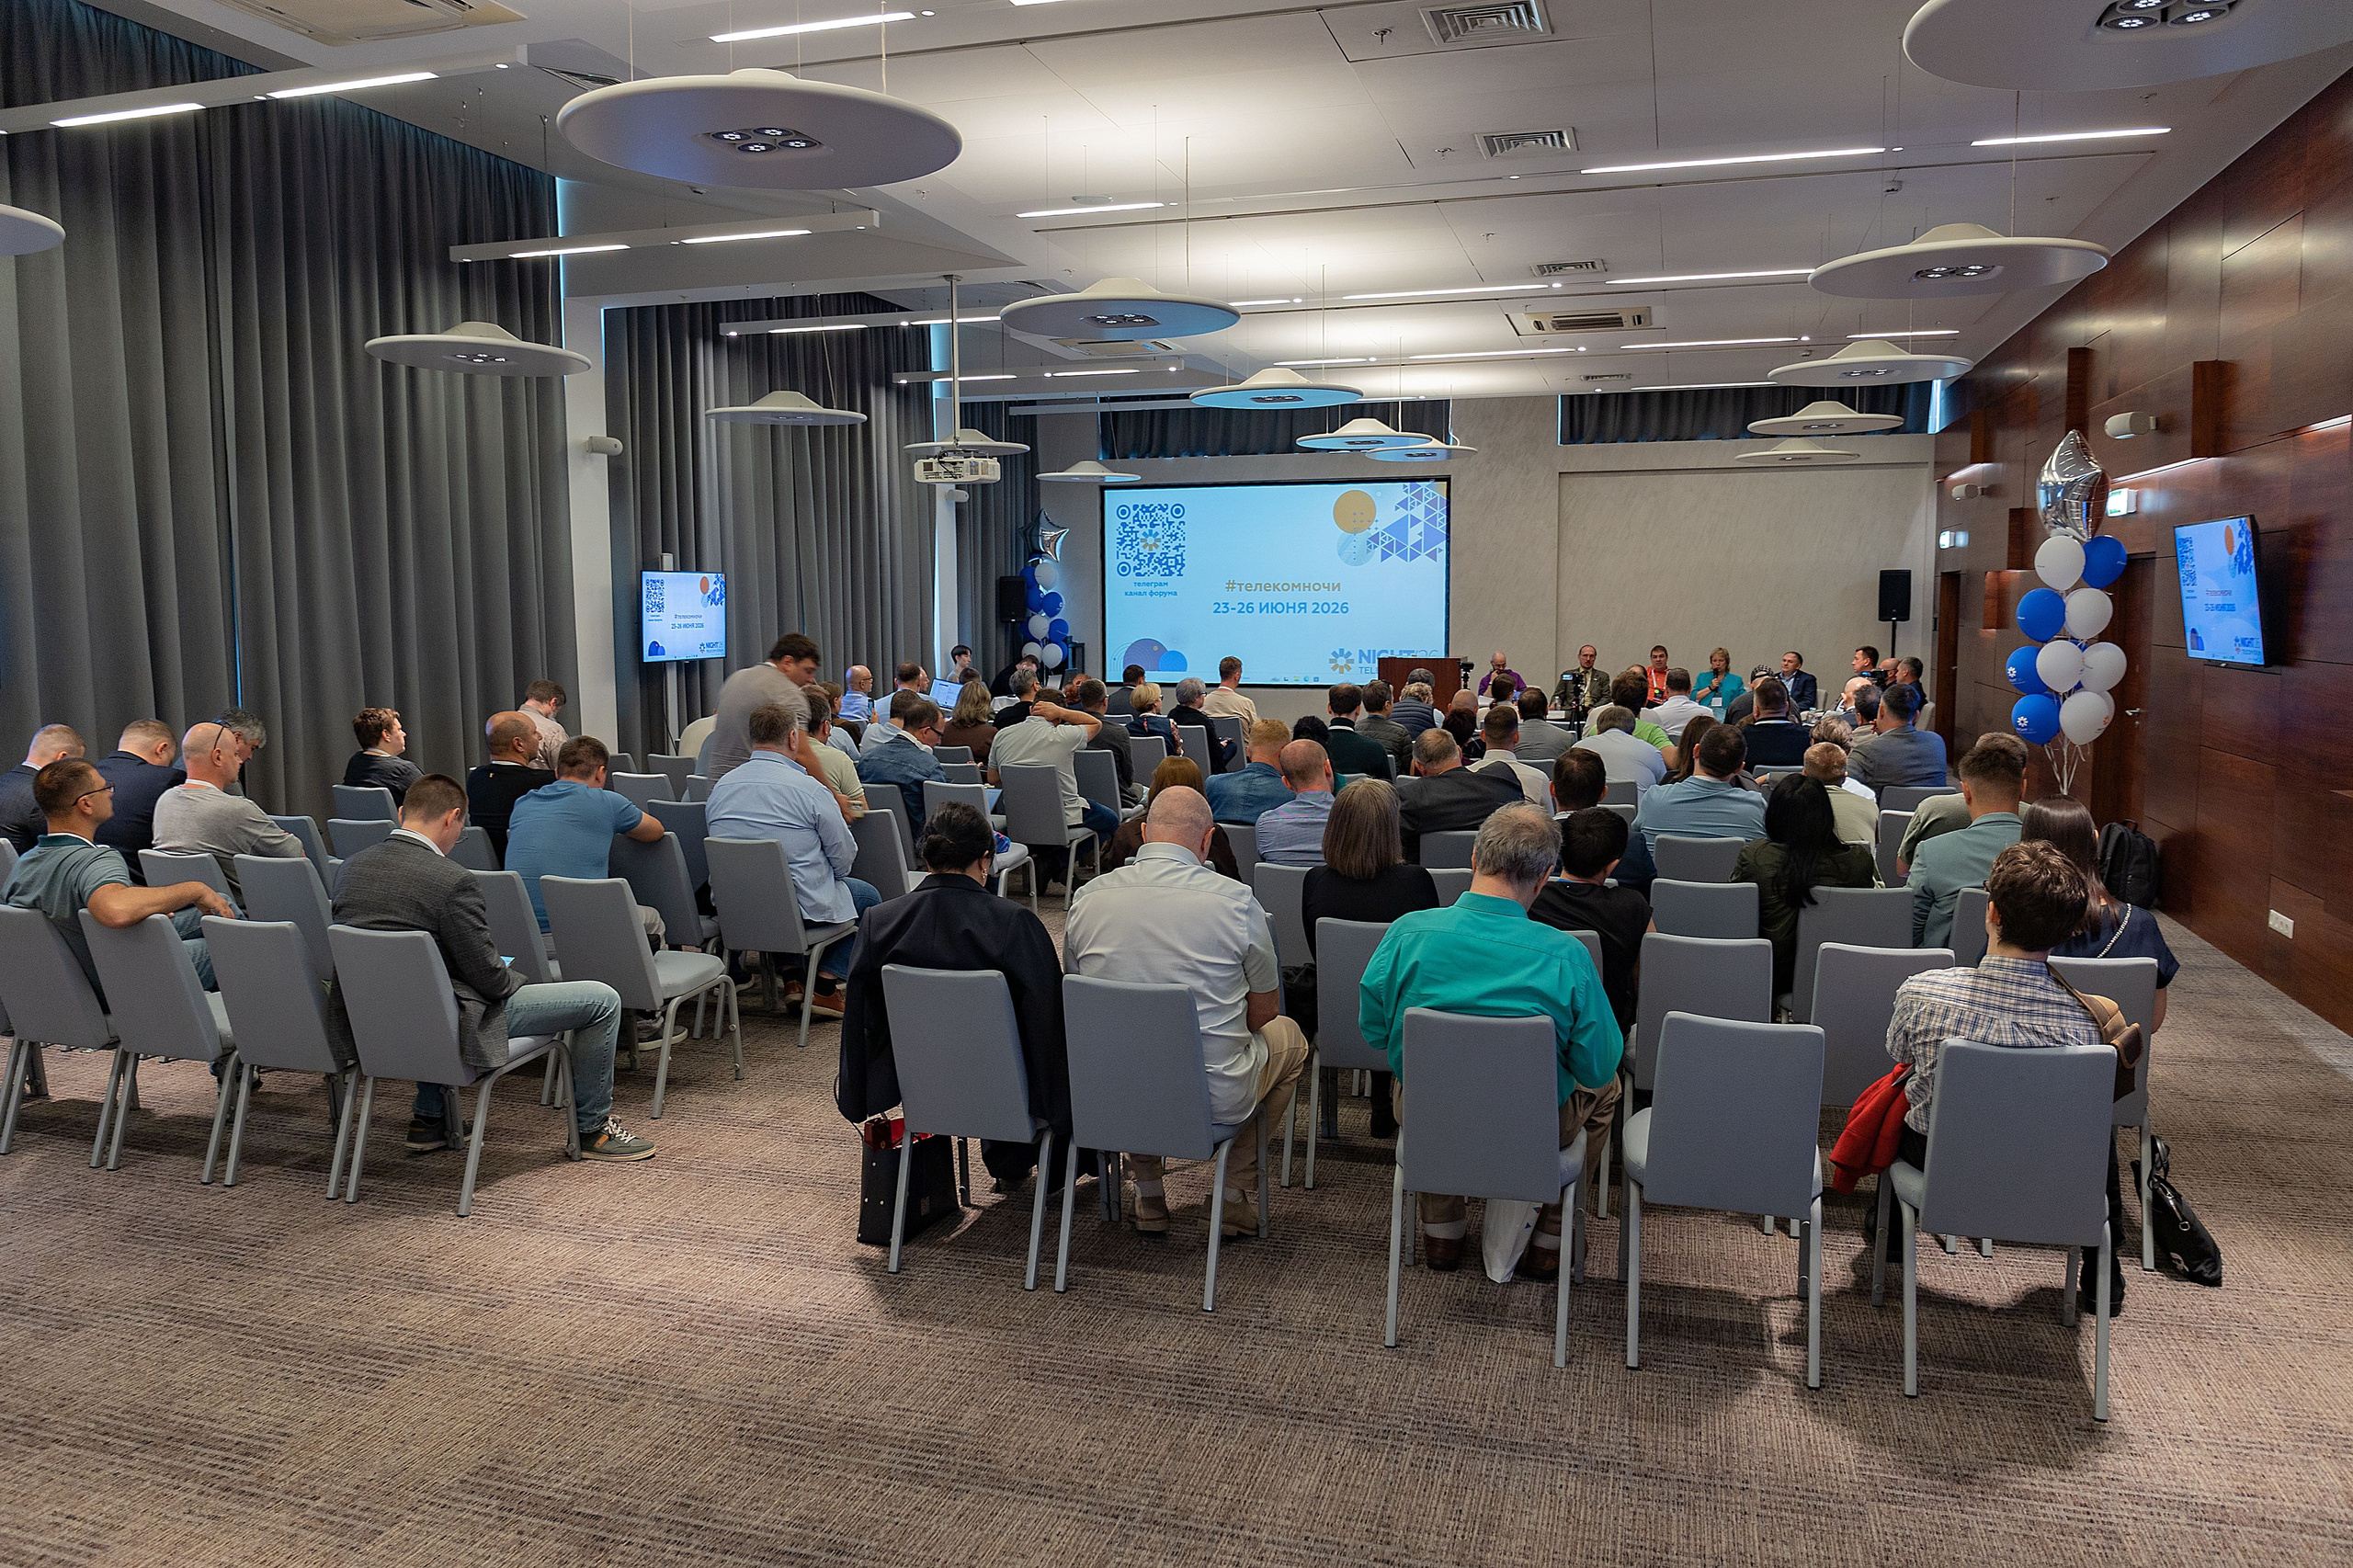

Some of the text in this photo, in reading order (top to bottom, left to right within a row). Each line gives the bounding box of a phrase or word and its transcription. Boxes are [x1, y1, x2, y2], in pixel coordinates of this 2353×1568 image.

[1225, 579, 1341, 592] #телекомночи
[1212, 601, 1349, 614] 23-26 ИЮНЯ 2026
